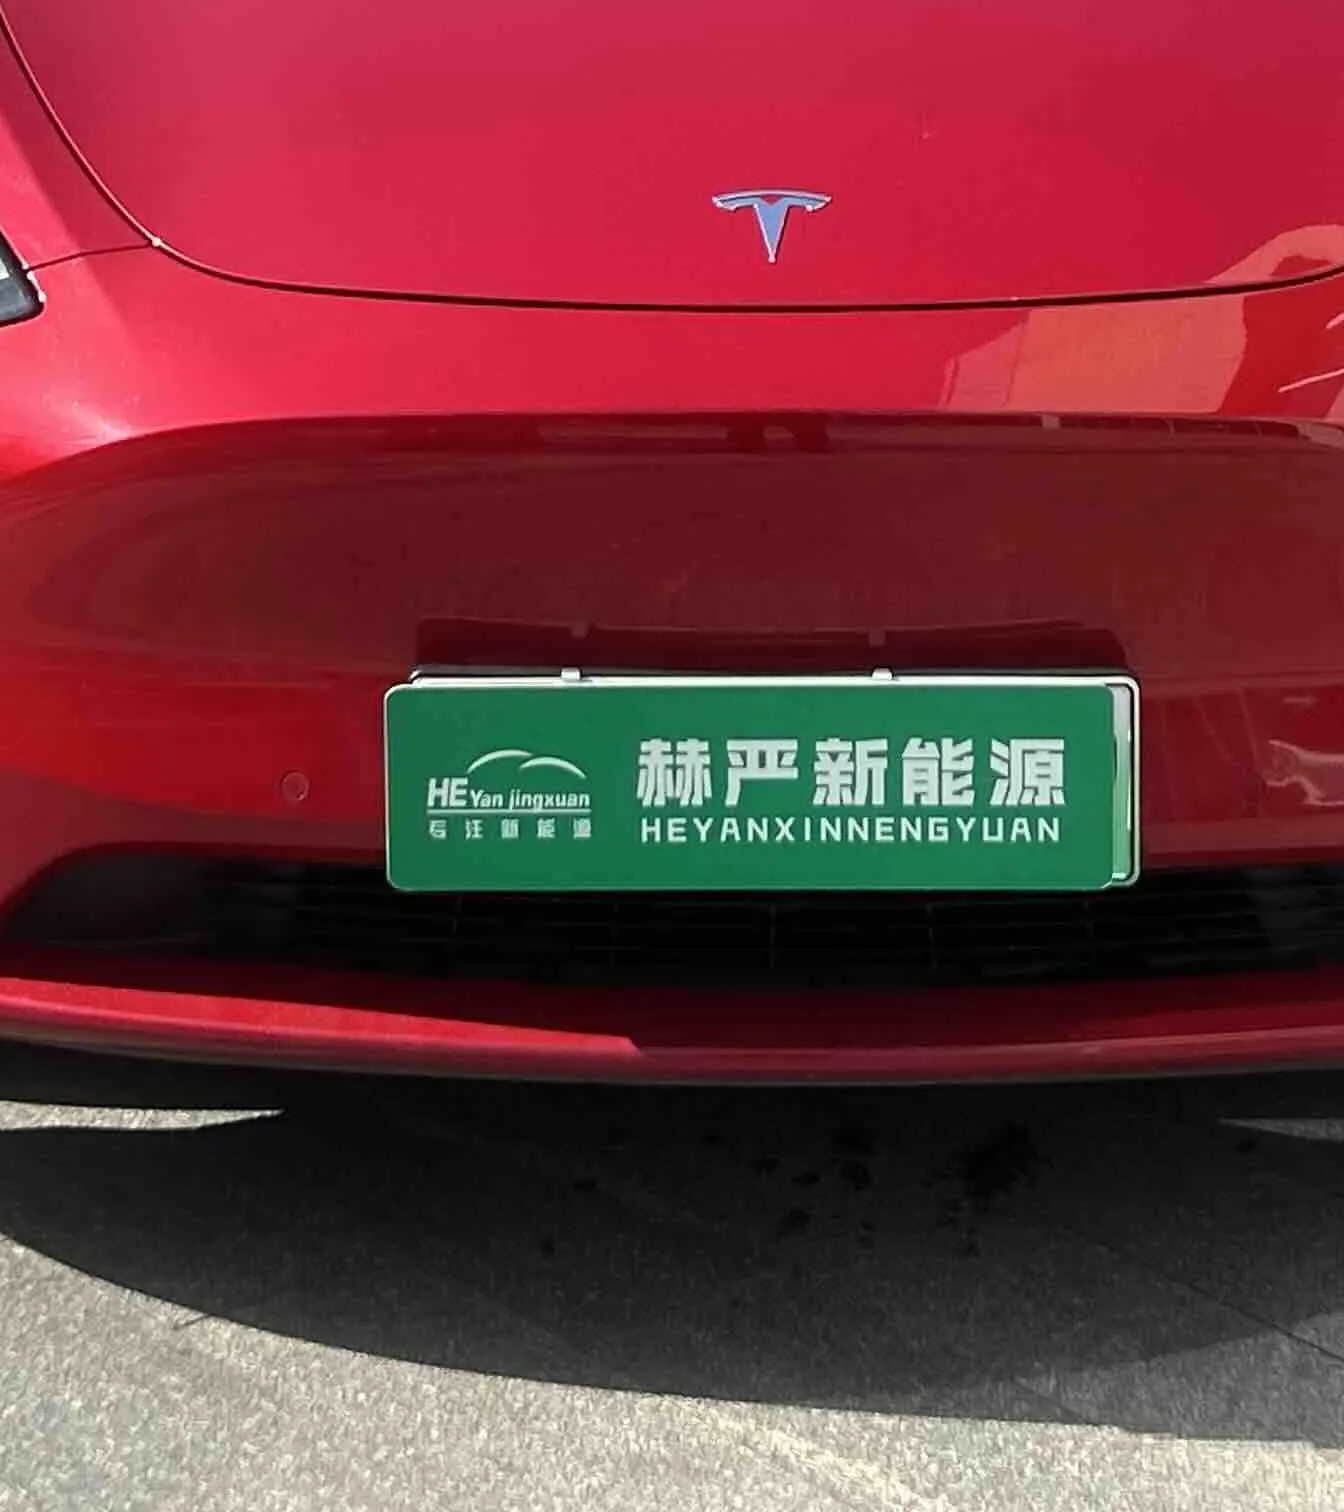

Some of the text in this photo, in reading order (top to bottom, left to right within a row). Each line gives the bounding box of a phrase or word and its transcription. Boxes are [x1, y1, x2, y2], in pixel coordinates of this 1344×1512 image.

[636, 737, 1066, 808] 赫严新能源
[508, 788, 591, 812] jingxuan
[640, 816, 1061, 843] HEYANXINNENGYUAN
